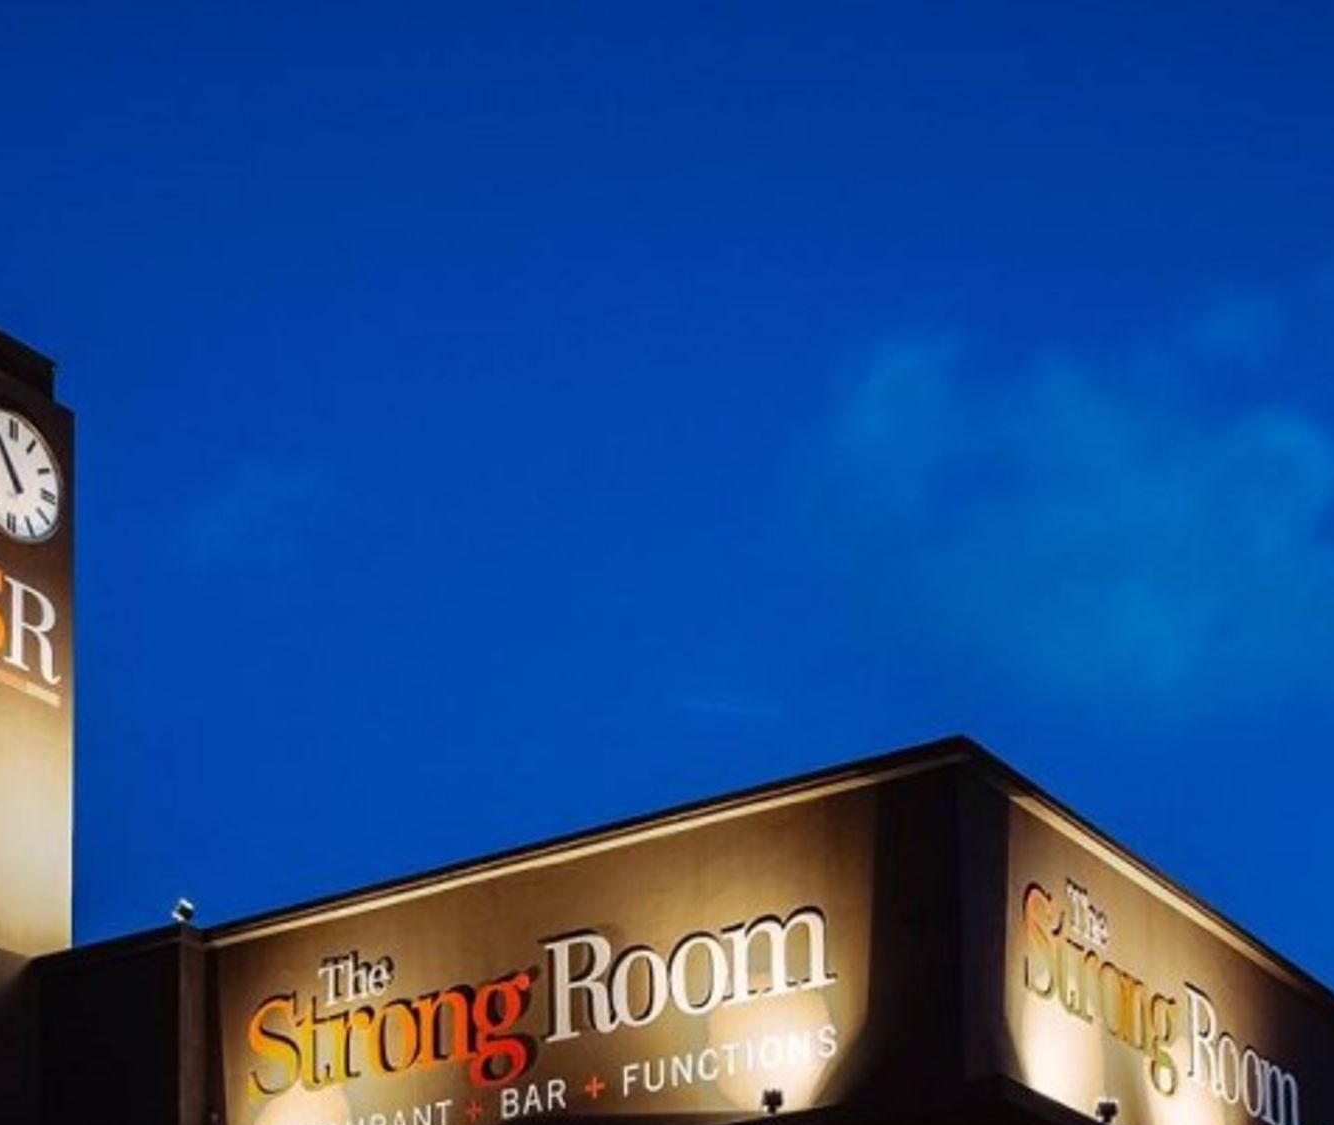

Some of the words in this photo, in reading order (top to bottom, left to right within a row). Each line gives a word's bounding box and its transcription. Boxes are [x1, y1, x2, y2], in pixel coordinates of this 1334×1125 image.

[1067, 877, 1110, 949] The
[245, 967, 537, 1101] Strong
[543, 908, 837, 1043] Room
[318, 951, 394, 1006] The
[1022, 882, 1179, 1097] Strong
[501, 1078, 568, 1119] BAR
[621, 1025, 839, 1097] FUNCTIONS
